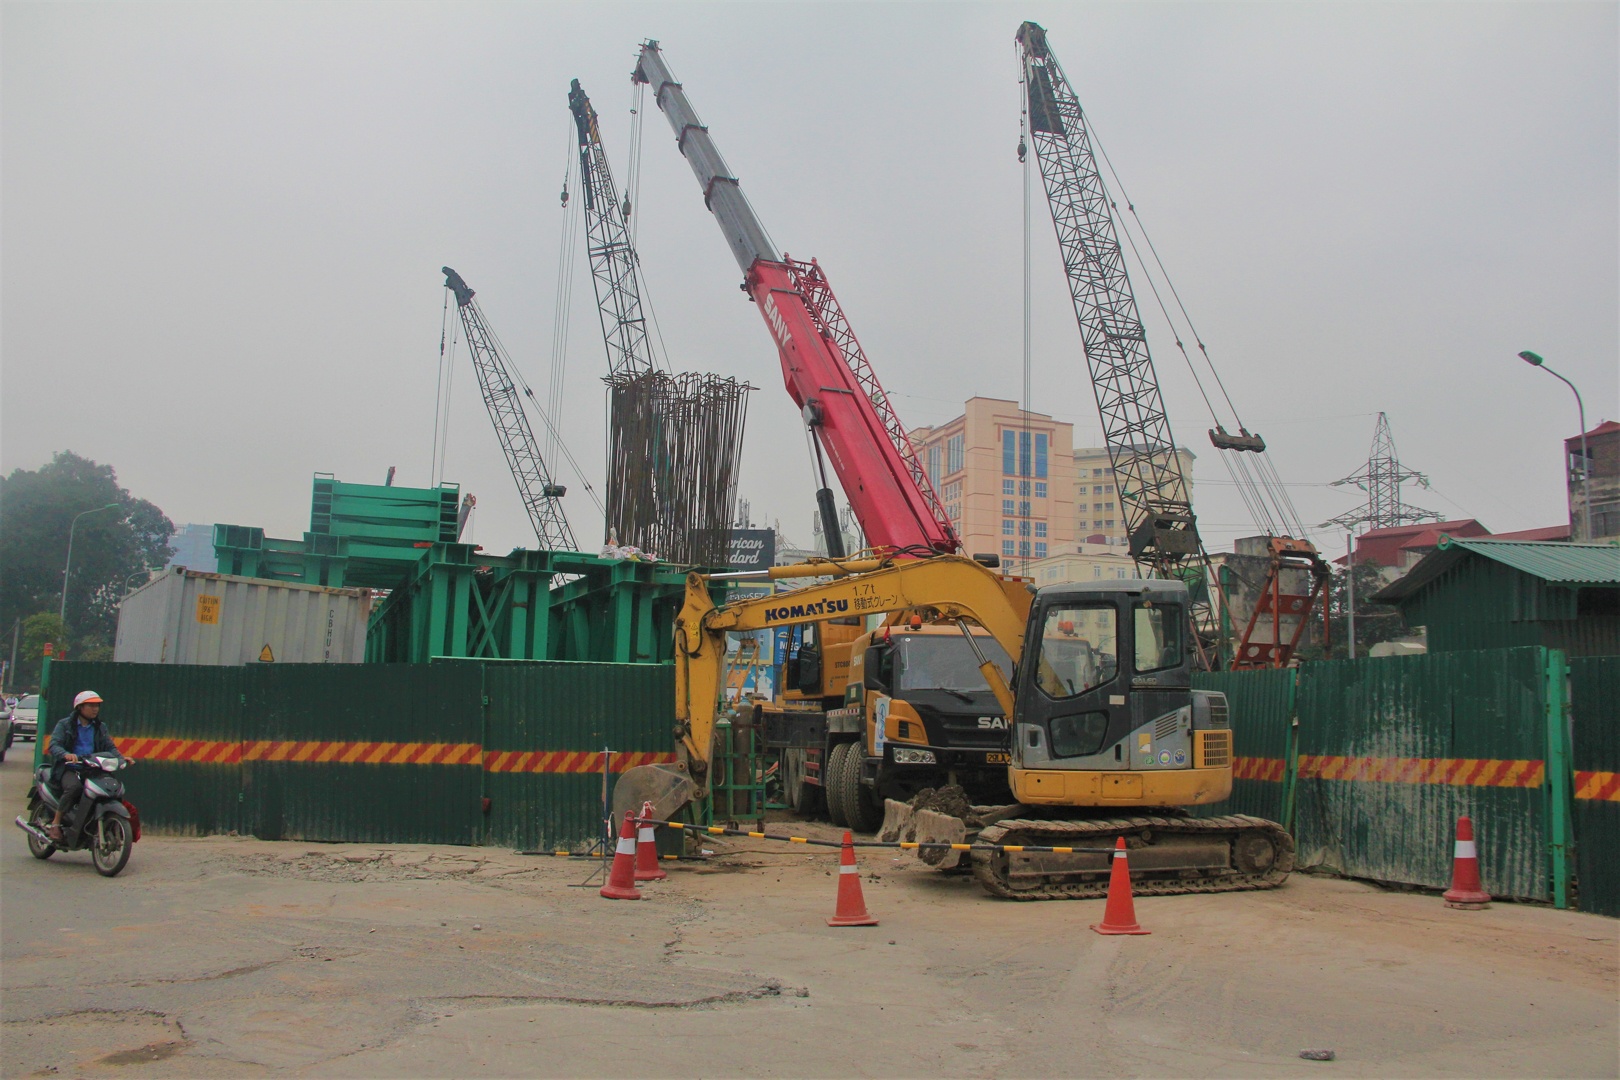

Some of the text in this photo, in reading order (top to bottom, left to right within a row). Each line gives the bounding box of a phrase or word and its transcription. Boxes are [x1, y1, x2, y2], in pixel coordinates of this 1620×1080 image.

[764, 292, 792, 347] SANY
[852, 584, 875, 596] 1.7t
[853, 594, 899, 610] 移動式クレーン
[764, 598, 849, 624] KOMATSU
[326, 609, 335, 647] CBHU
